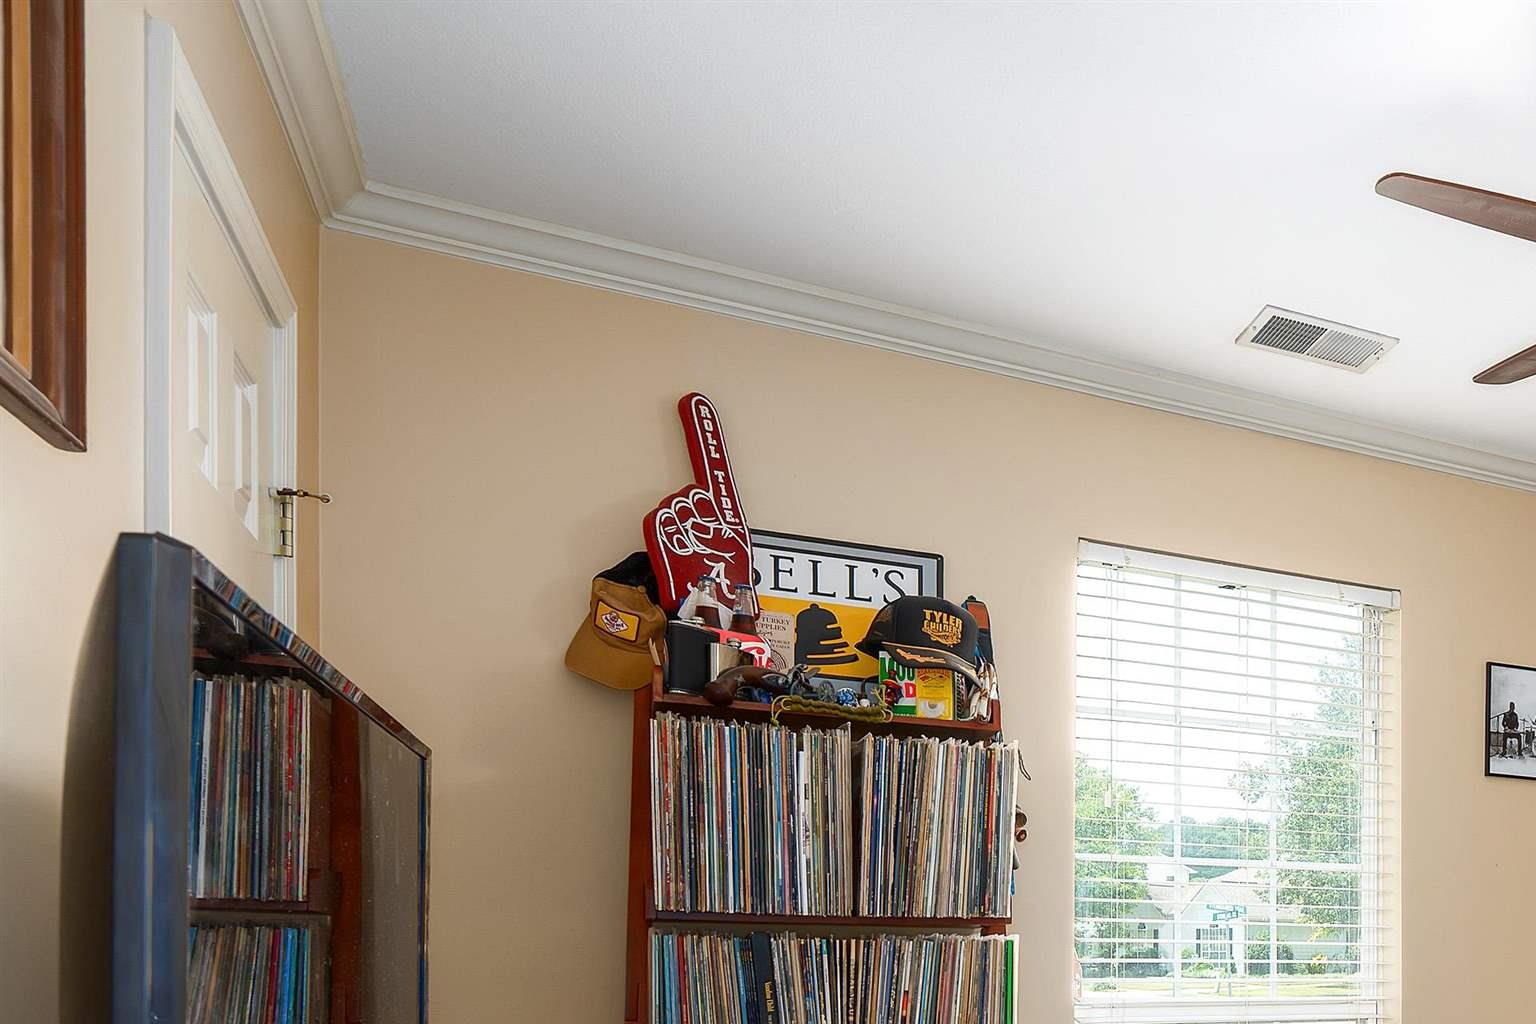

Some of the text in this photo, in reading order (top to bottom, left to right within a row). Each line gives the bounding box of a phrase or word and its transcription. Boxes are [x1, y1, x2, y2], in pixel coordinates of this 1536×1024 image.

[699, 405, 720, 459] ROLL
[752, 554, 906, 604] ELL'S
[762, 616, 790, 626] TURKEY
[922, 609, 963, 627] TYLER
